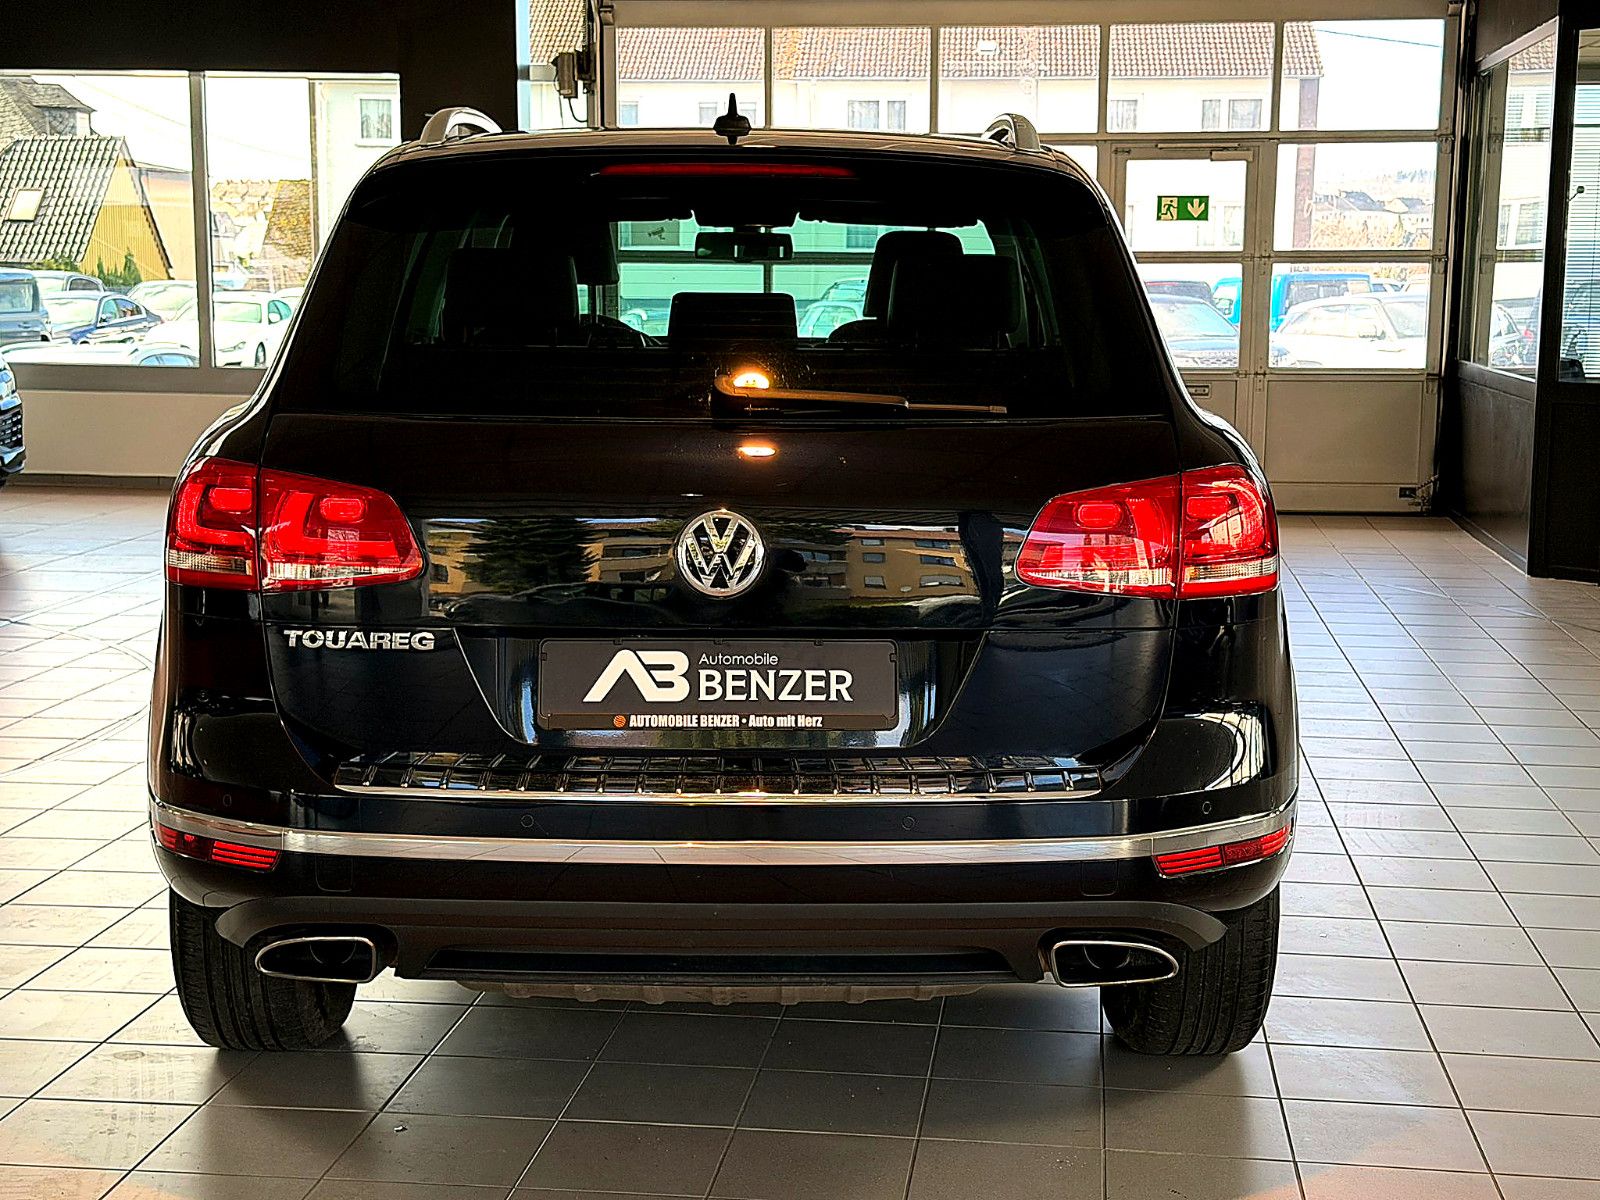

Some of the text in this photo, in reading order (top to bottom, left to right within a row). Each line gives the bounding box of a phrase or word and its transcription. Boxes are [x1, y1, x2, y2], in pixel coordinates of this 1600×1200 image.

[283, 629, 435, 650] TOUAREG
[699, 653, 779, 665] Automobile
[698, 669, 854, 701] BENZER
[629, 714, 823, 728] AUTOMOBILE BENZER Auto mit Herz
